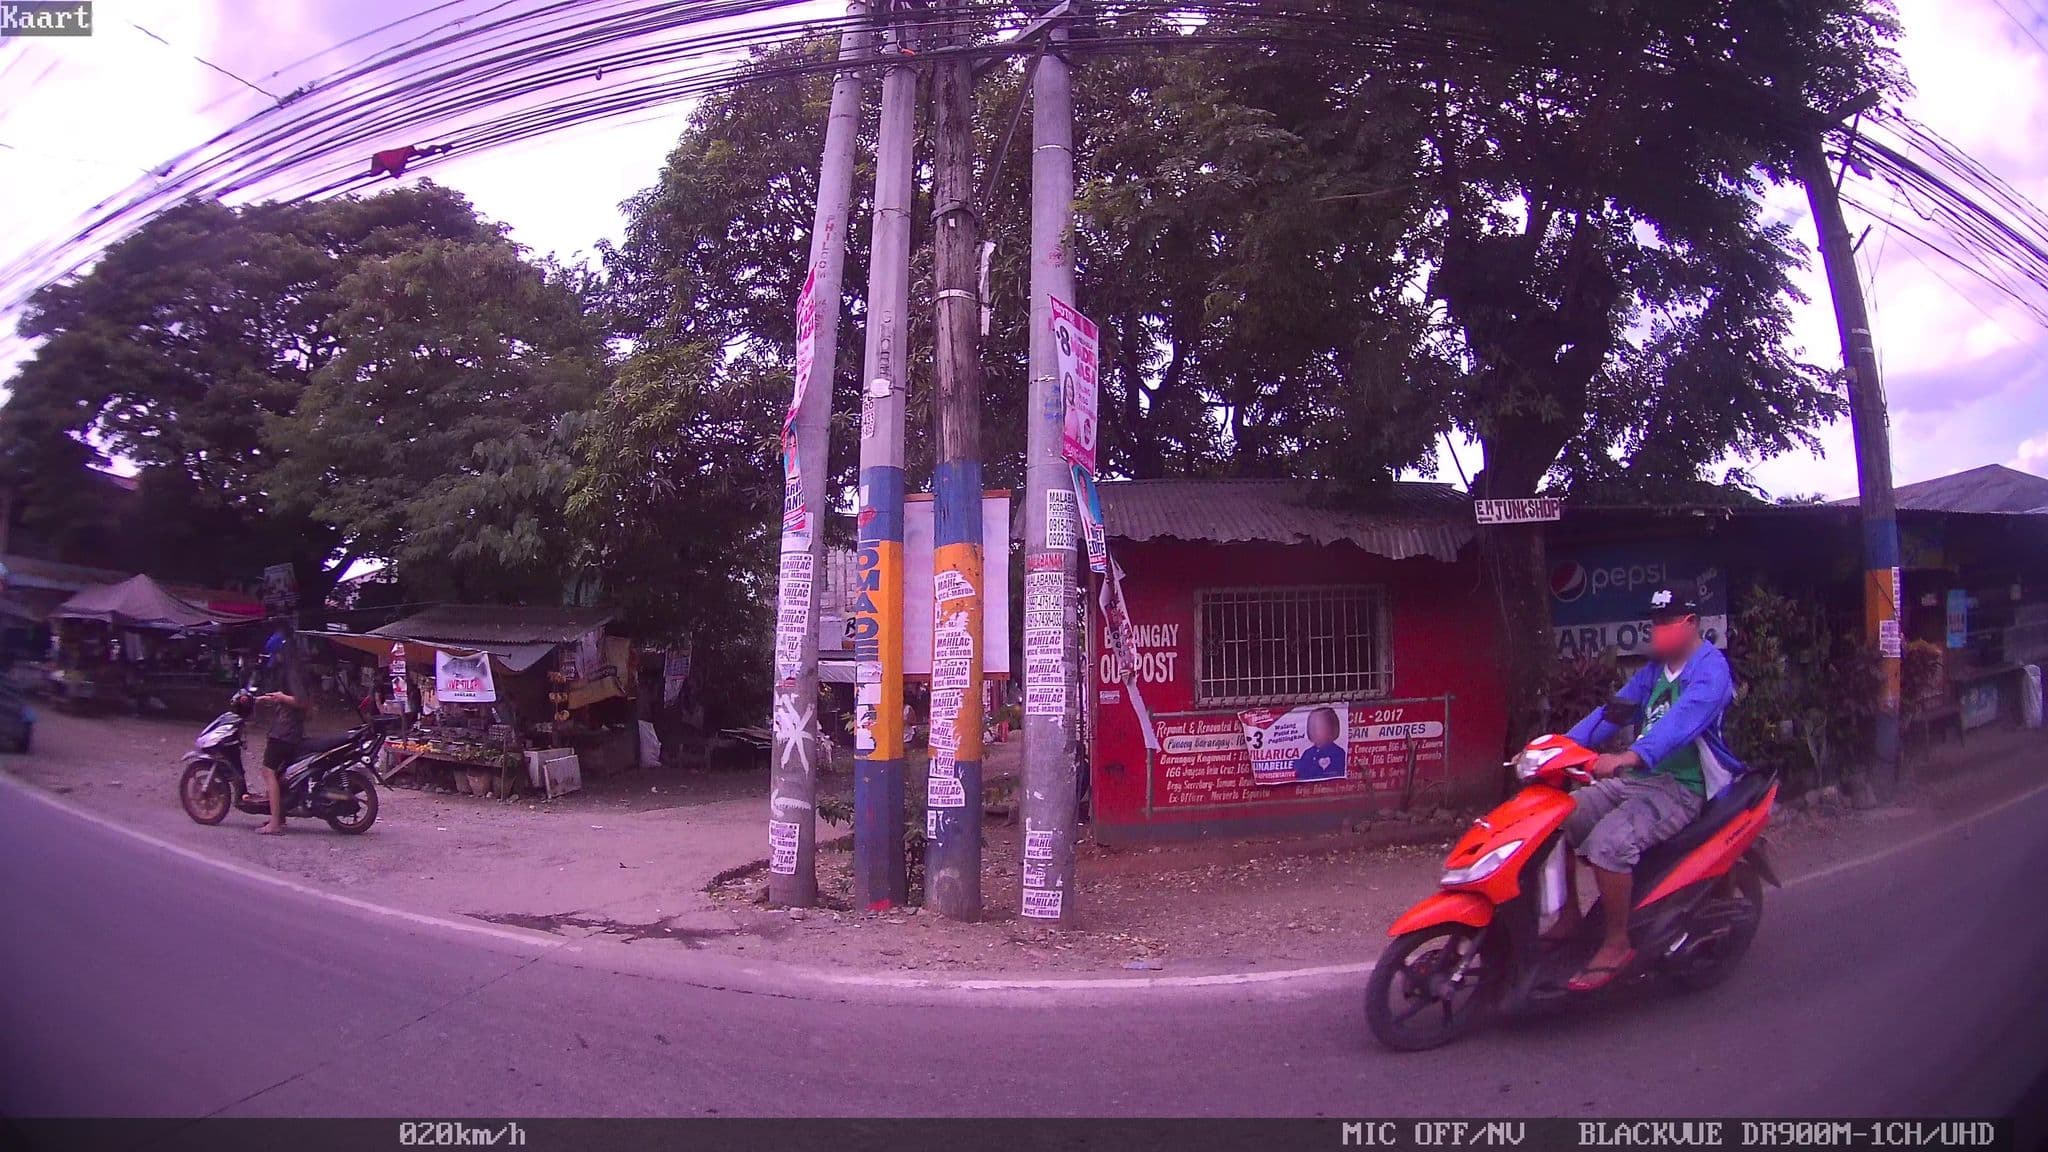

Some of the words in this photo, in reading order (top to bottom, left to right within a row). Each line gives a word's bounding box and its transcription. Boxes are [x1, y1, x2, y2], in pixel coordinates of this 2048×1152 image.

[1591, 563, 1667, 595] pepsi
[1104, 624, 1179, 649] BANGAY
[1100, 652, 1178, 683] OUPOST
[1379, 724, 1426, 737] ANDRES
